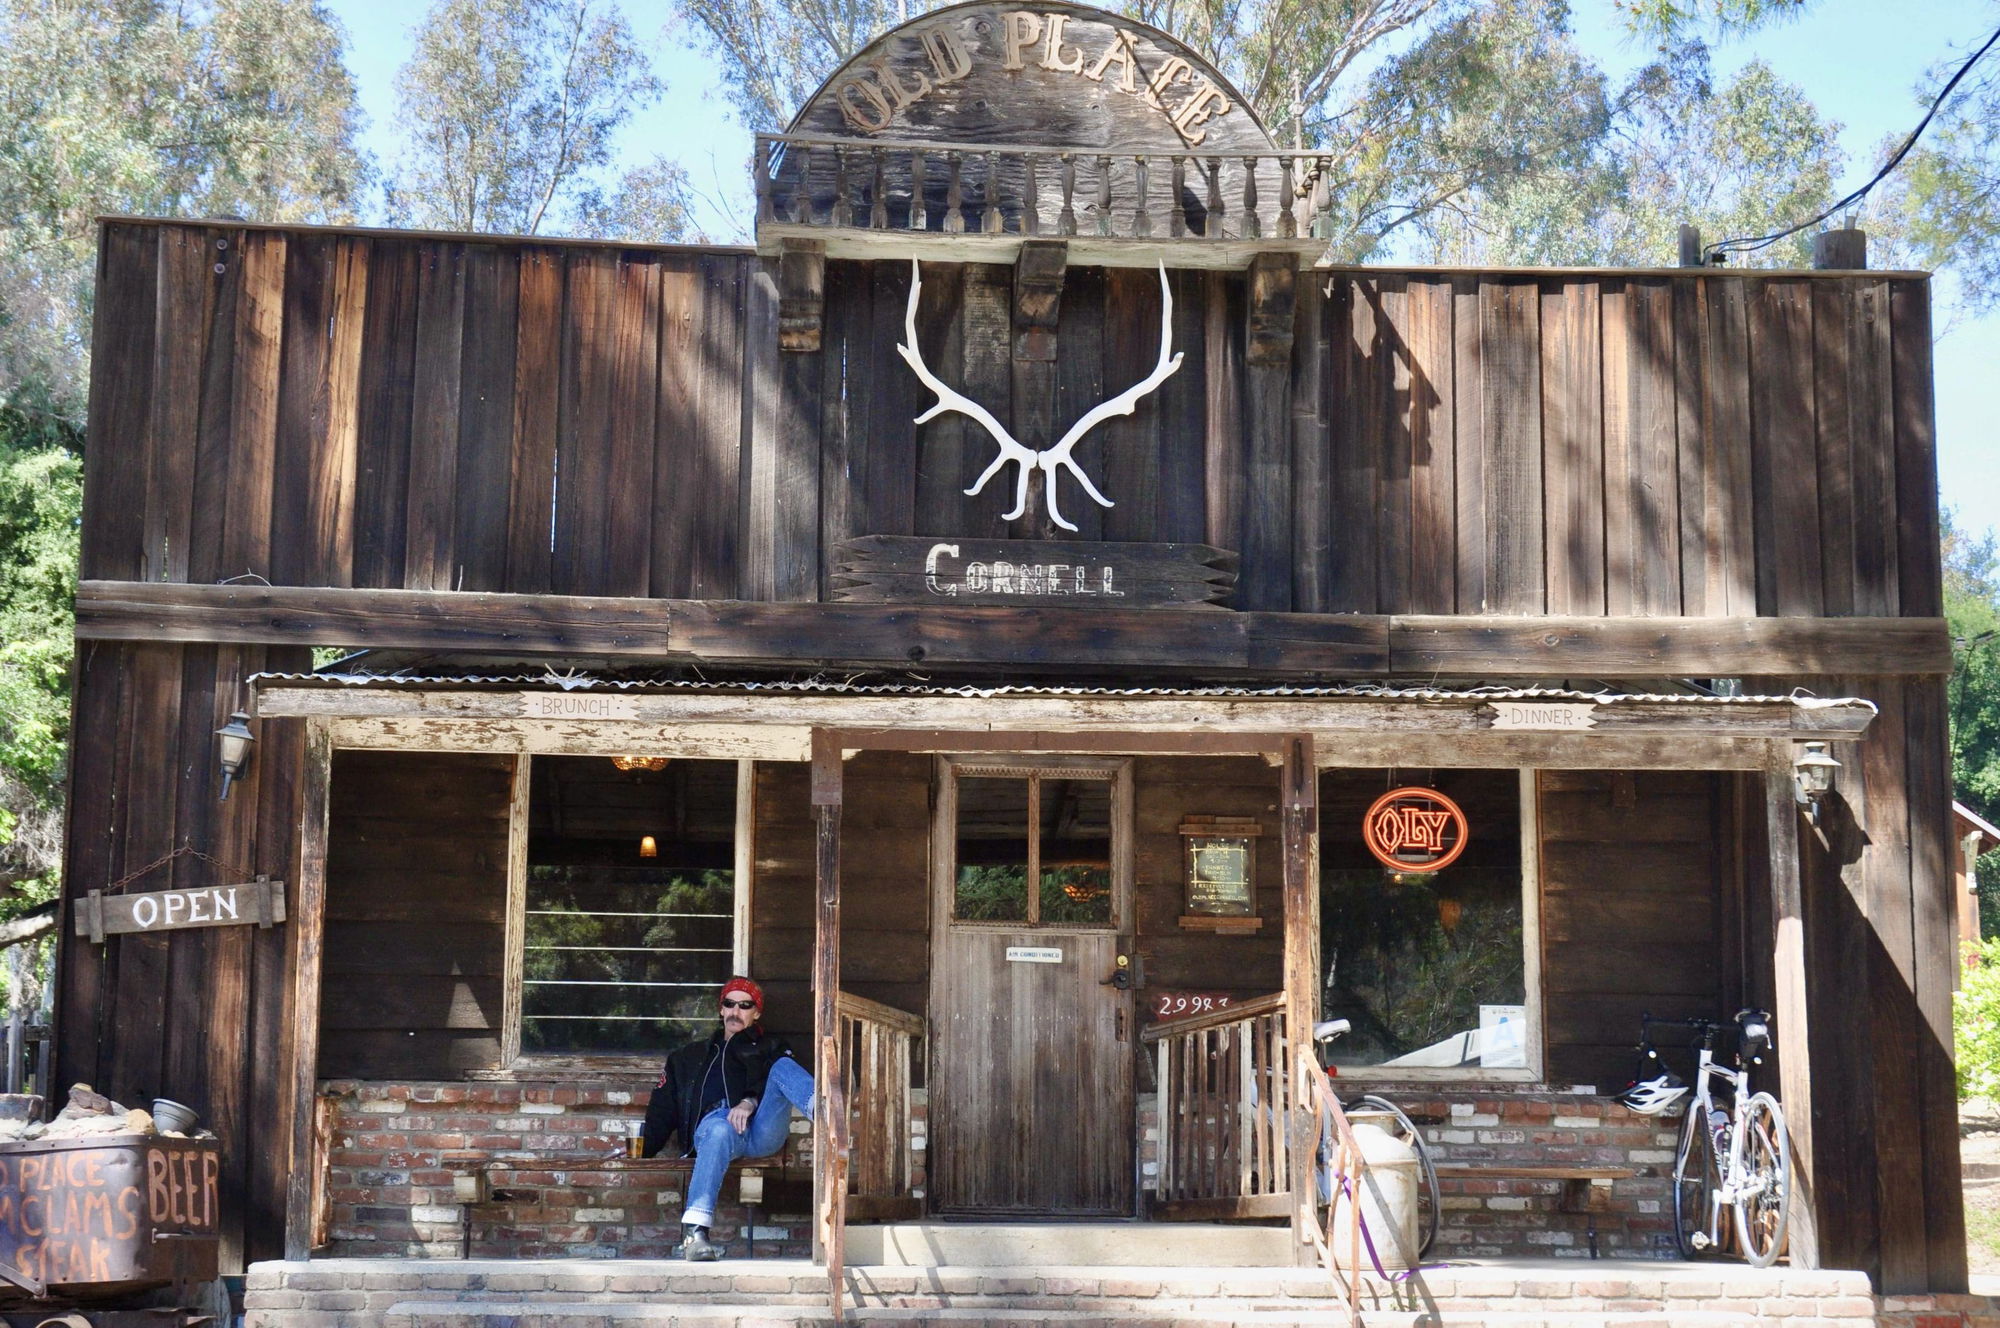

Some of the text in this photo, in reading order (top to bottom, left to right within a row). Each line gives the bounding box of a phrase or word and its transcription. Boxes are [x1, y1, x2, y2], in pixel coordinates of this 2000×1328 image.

[835, 11, 1232, 146] OLD PLACE
[925, 543, 1125, 597] CORNELL
[541, 696, 610, 716] BRUNCH
[1511, 707, 1574, 726] DINNER
[1374, 807, 1452, 854] OLY
[132, 888, 239, 928] OPEN
[19, 1152, 105, 1192] PLACE
[147, 1149, 219, 1226] BEER
[21, 1186, 139, 1240] CLAMS
[16, 1237, 111, 1283] STEAK
